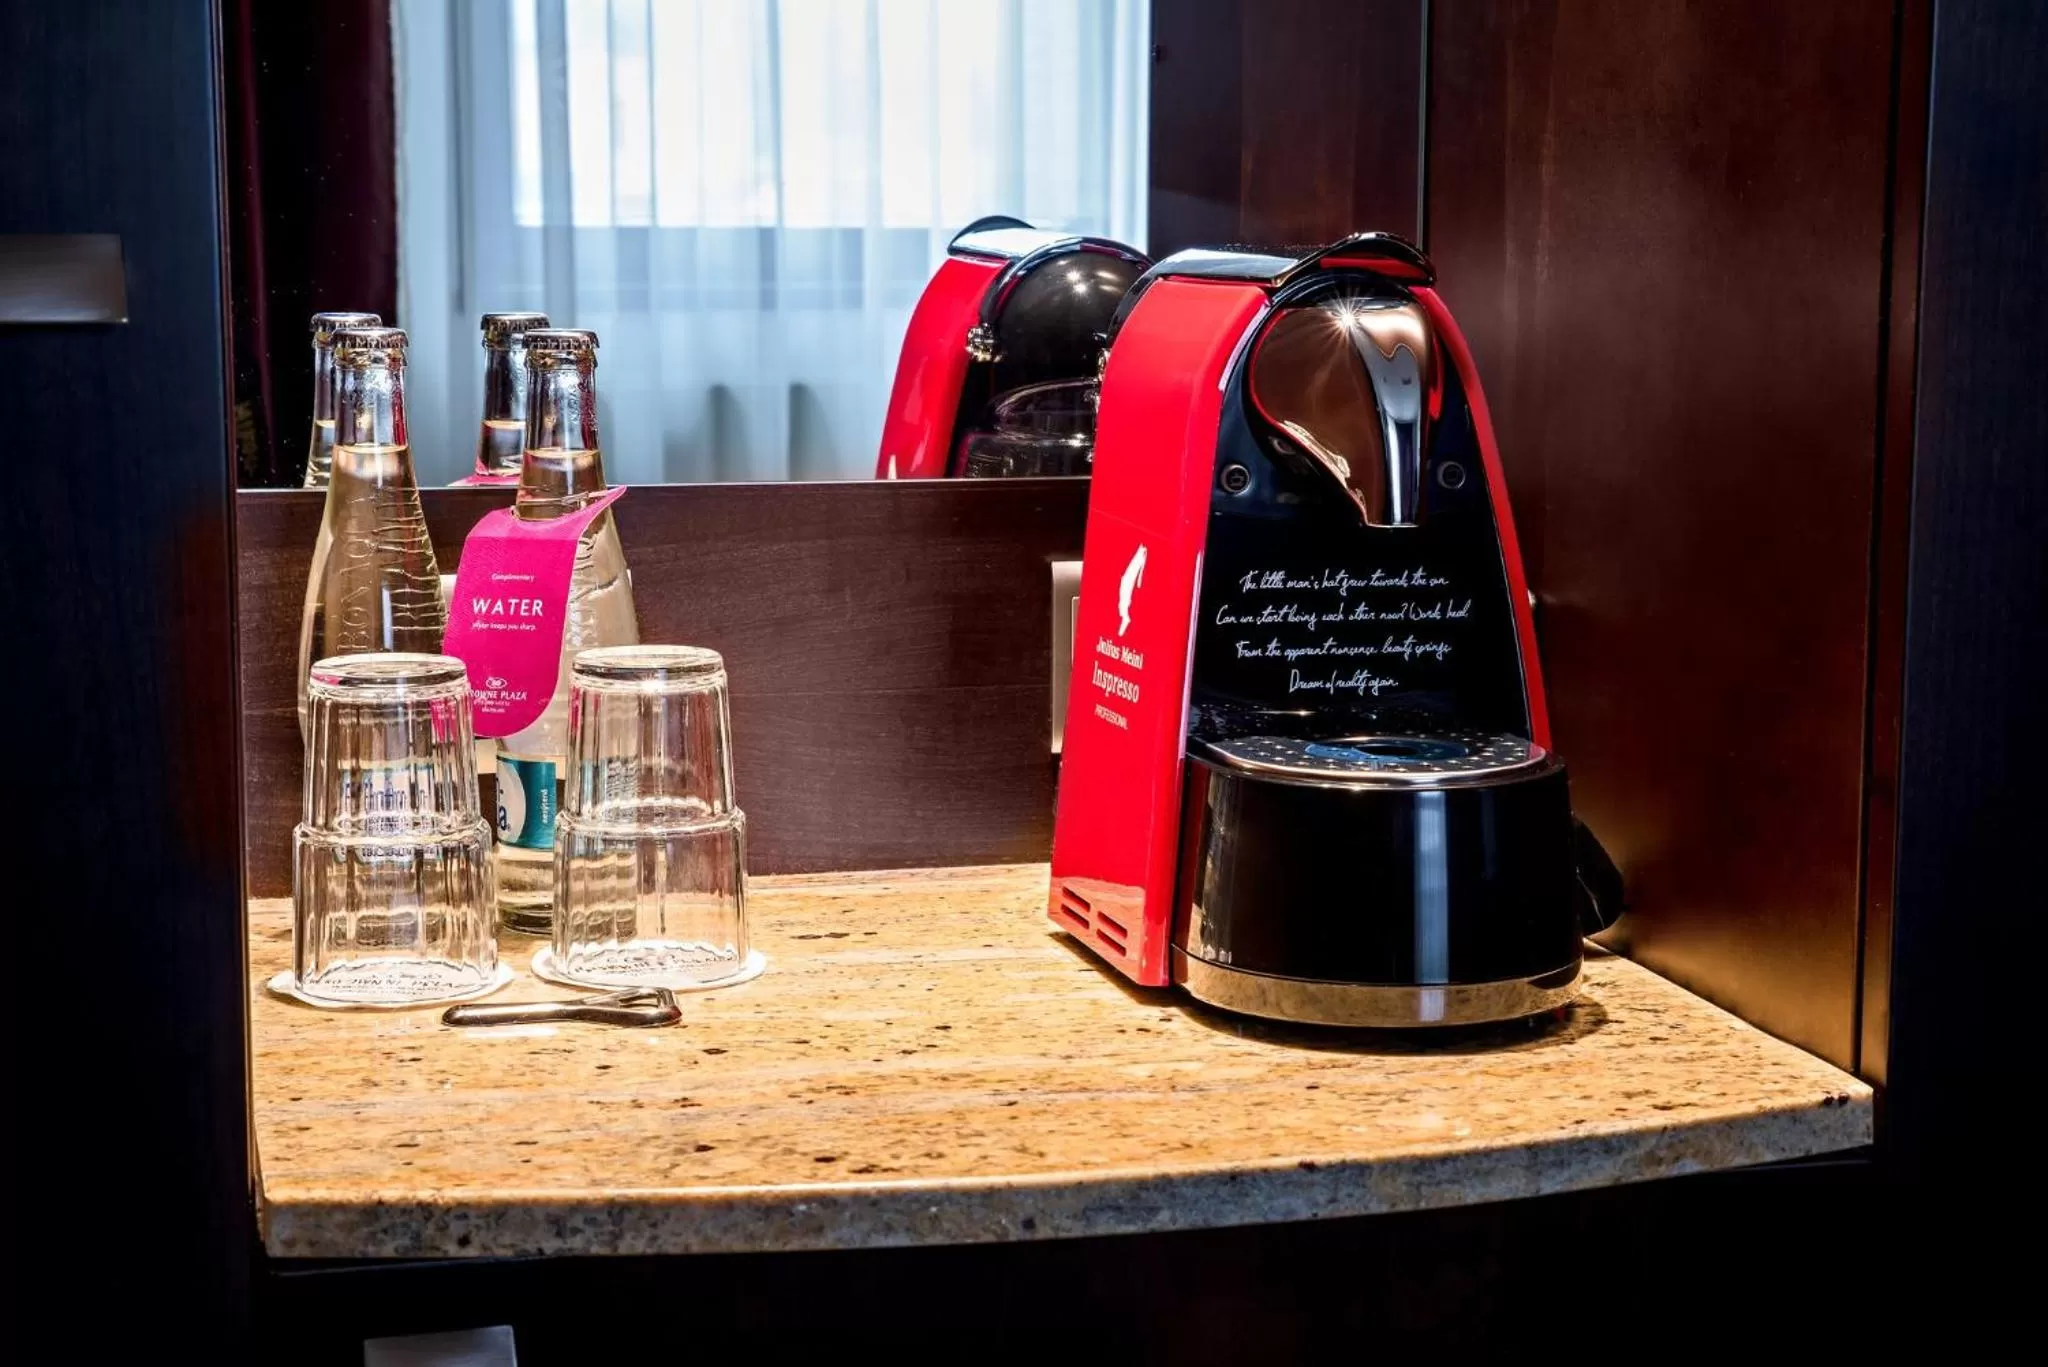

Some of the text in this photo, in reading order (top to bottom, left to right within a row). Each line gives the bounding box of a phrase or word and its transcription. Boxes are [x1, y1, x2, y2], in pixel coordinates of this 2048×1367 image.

[1239, 570, 1259, 593] The
[1259, 570, 1285, 589] little
[1286, 575, 1319, 590] man's
[1321, 568, 1349, 589] hat
[1339, 578, 1367, 596] grew
[1369, 568, 1409, 588] towards
[1410, 565, 1427, 586] the
[471, 598, 543, 616] WATER
[1216, 604, 1238, 625] Can
[1239, 615, 1254, 623] we
[1255, 604, 1291, 625] start
[1322, 602, 1344, 621] each
[1348, 601, 1375, 621] other
[1379, 602, 1408, 621] now?
[1409, 601, 1442, 621] Words
[1096, 635, 1145, 670] Julius Meinl
[1235, 640, 1263, 659] From
[1264, 637, 1281, 656] the
[1284, 637, 1338, 661] apparent
[1382, 635, 1417, 662] beauty
[500, 690, 528, 700] PLAZA
[1092, 660, 1141, 704] Inspresso
[1289, 668, 1324, 693] Dream
[1324, 669, 1338, 695] of
[1335, 669, 1372, 696] reality
[1094, 703, 1129, 731] PROFESSIONAL
